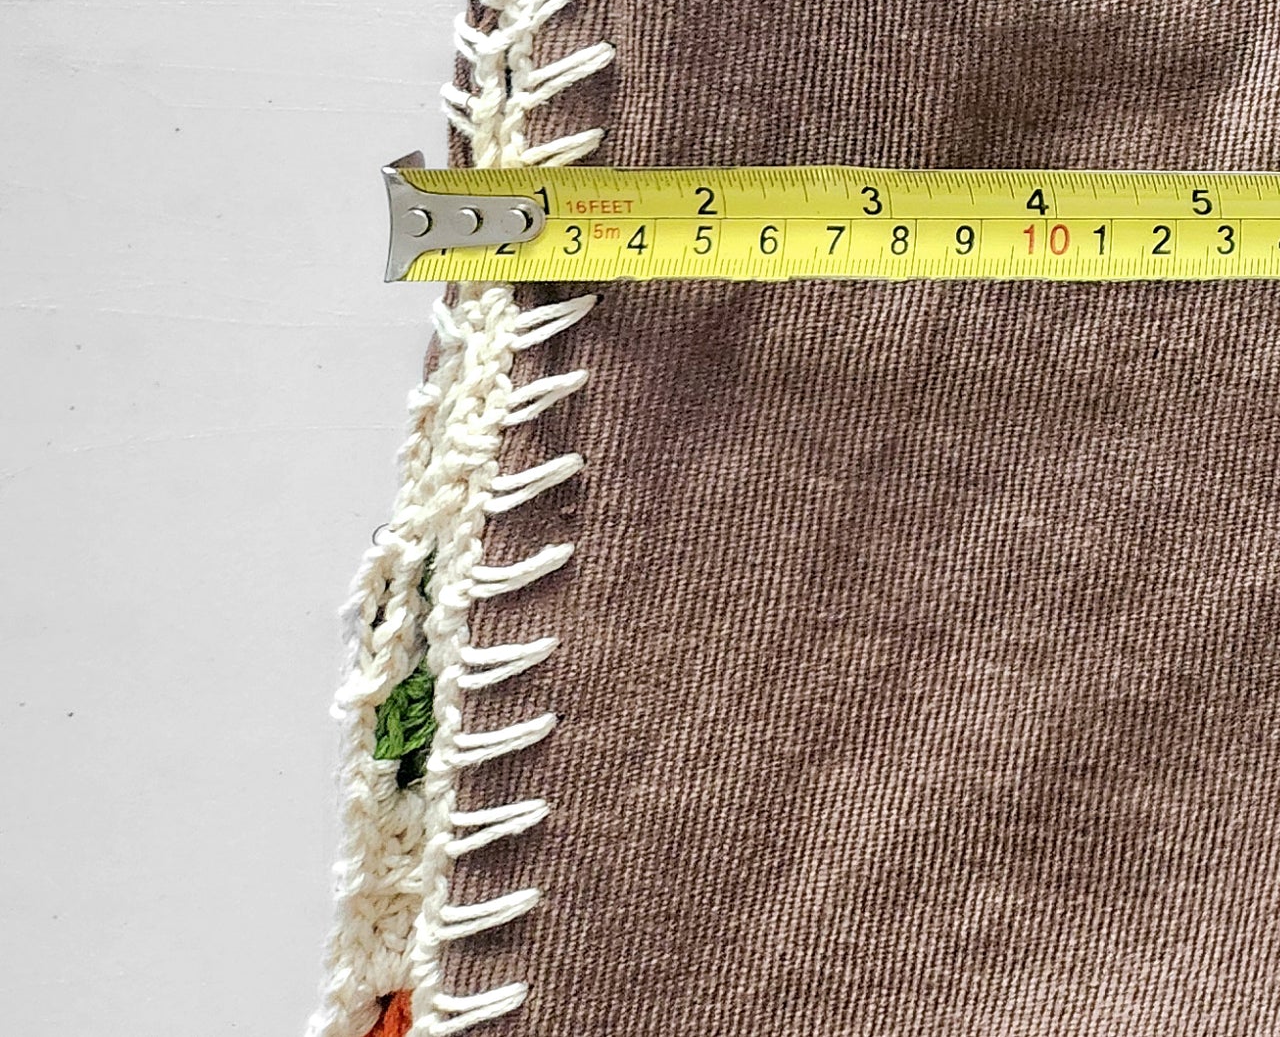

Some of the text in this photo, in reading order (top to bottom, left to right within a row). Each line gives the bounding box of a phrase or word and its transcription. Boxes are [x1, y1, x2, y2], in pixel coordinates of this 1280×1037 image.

[534, 187, 550, 215] 1
[697, 187, 716, 215] 2
[862, 186, 882, 214] 3
[1027, 189, 1049, 215] 4
[1193, 190, 1212, 215] 5
[563, 225, 582, 255] 3
[594, 224, 620, 239] 5m
[627, 225, 649, 255] 4
[694, 225, 713, 254] 5
[760, 225, 779, 254] 6
[827, 225, 846, 254] 7
[891, 225, 909, 255] 8
[955, 225, 975, 254] 9
[1023, 224, 1070, 255] 10
[1094, 225, 1106, 255] 1
[1152, 225, 1171, 255] 2
[1217, 225, 1235, 255] 3
